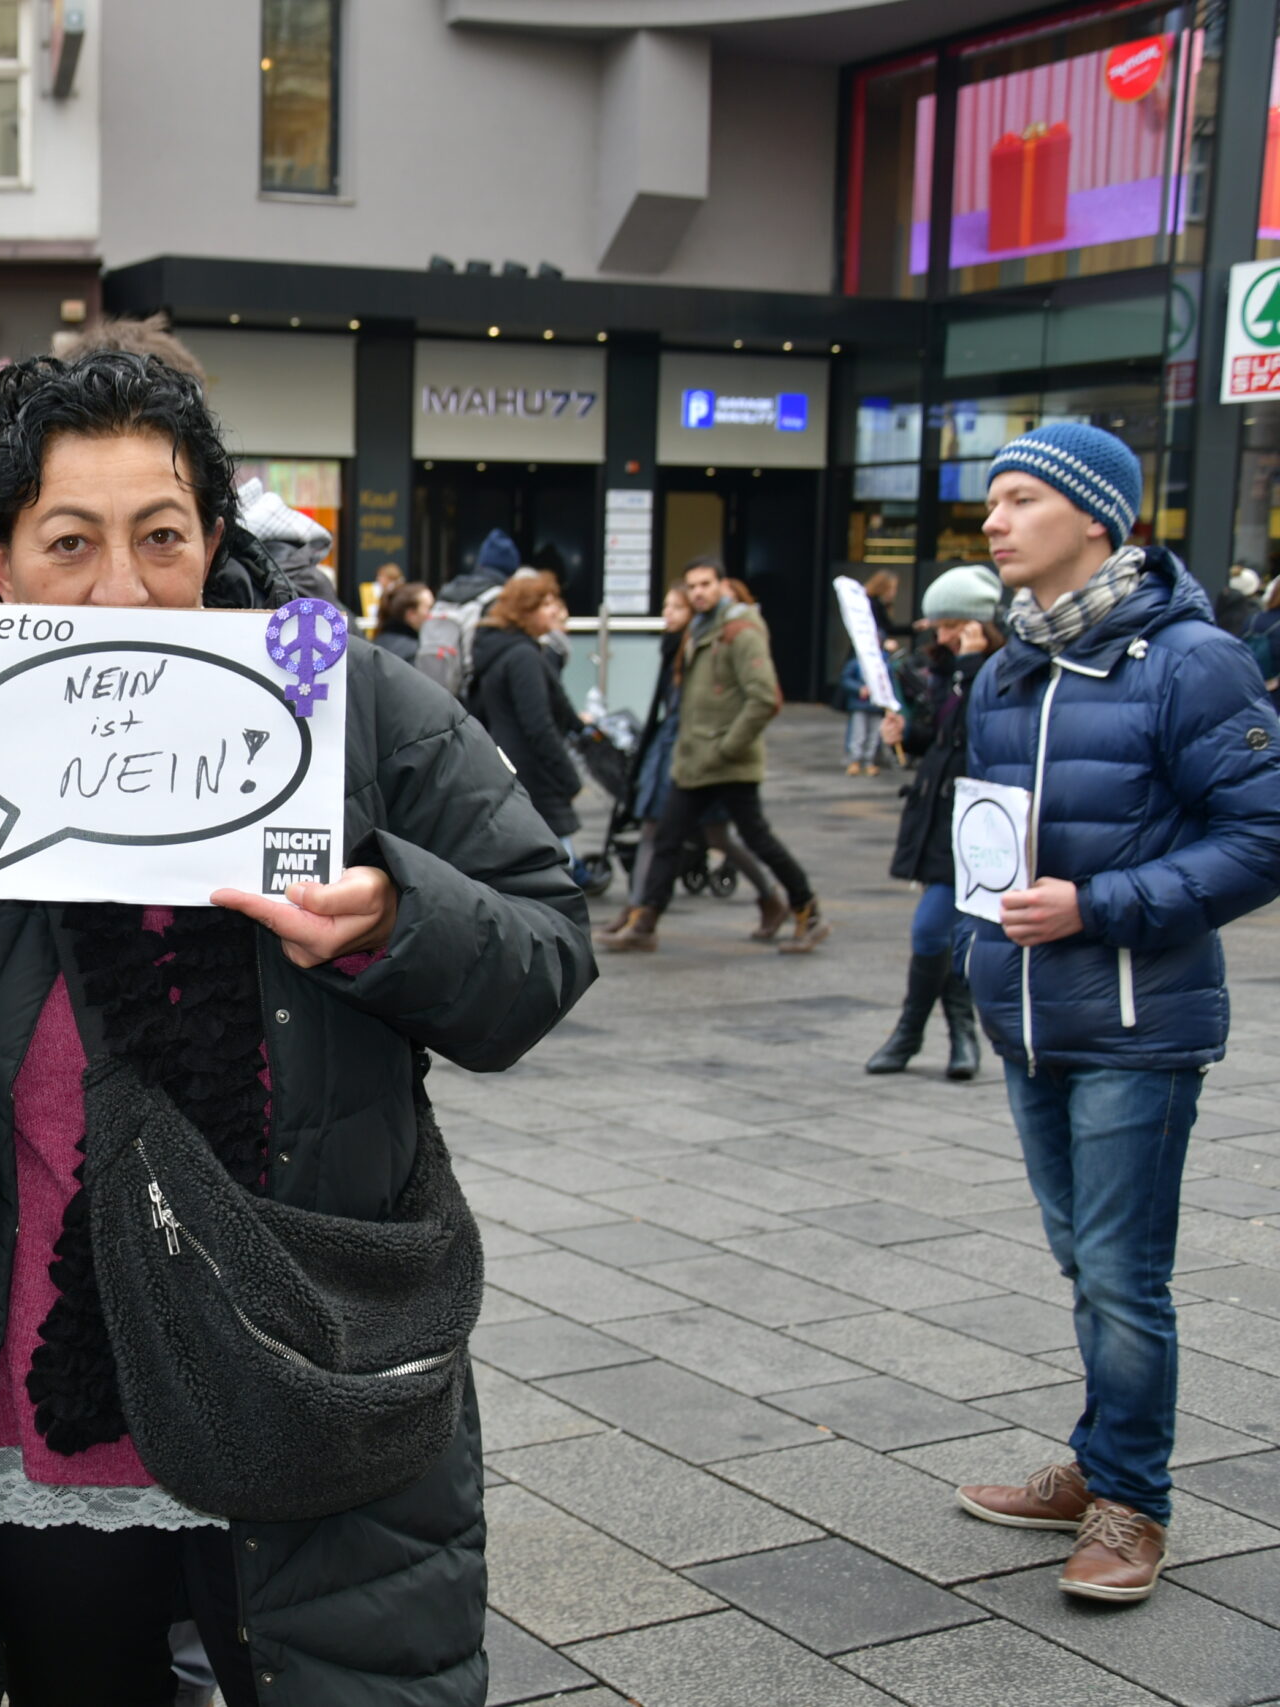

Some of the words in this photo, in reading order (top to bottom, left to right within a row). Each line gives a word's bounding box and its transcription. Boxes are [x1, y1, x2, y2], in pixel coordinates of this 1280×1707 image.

[422, 385, 598, 418] MAHU77
[64, 659, 167, 703] NEIN
[91, 710, 144, 737] ist
[60, 728, 270, 799] NEIN!
[265, 832, 330, 851] NICHT
[276, 853, 318, 871] MIT
